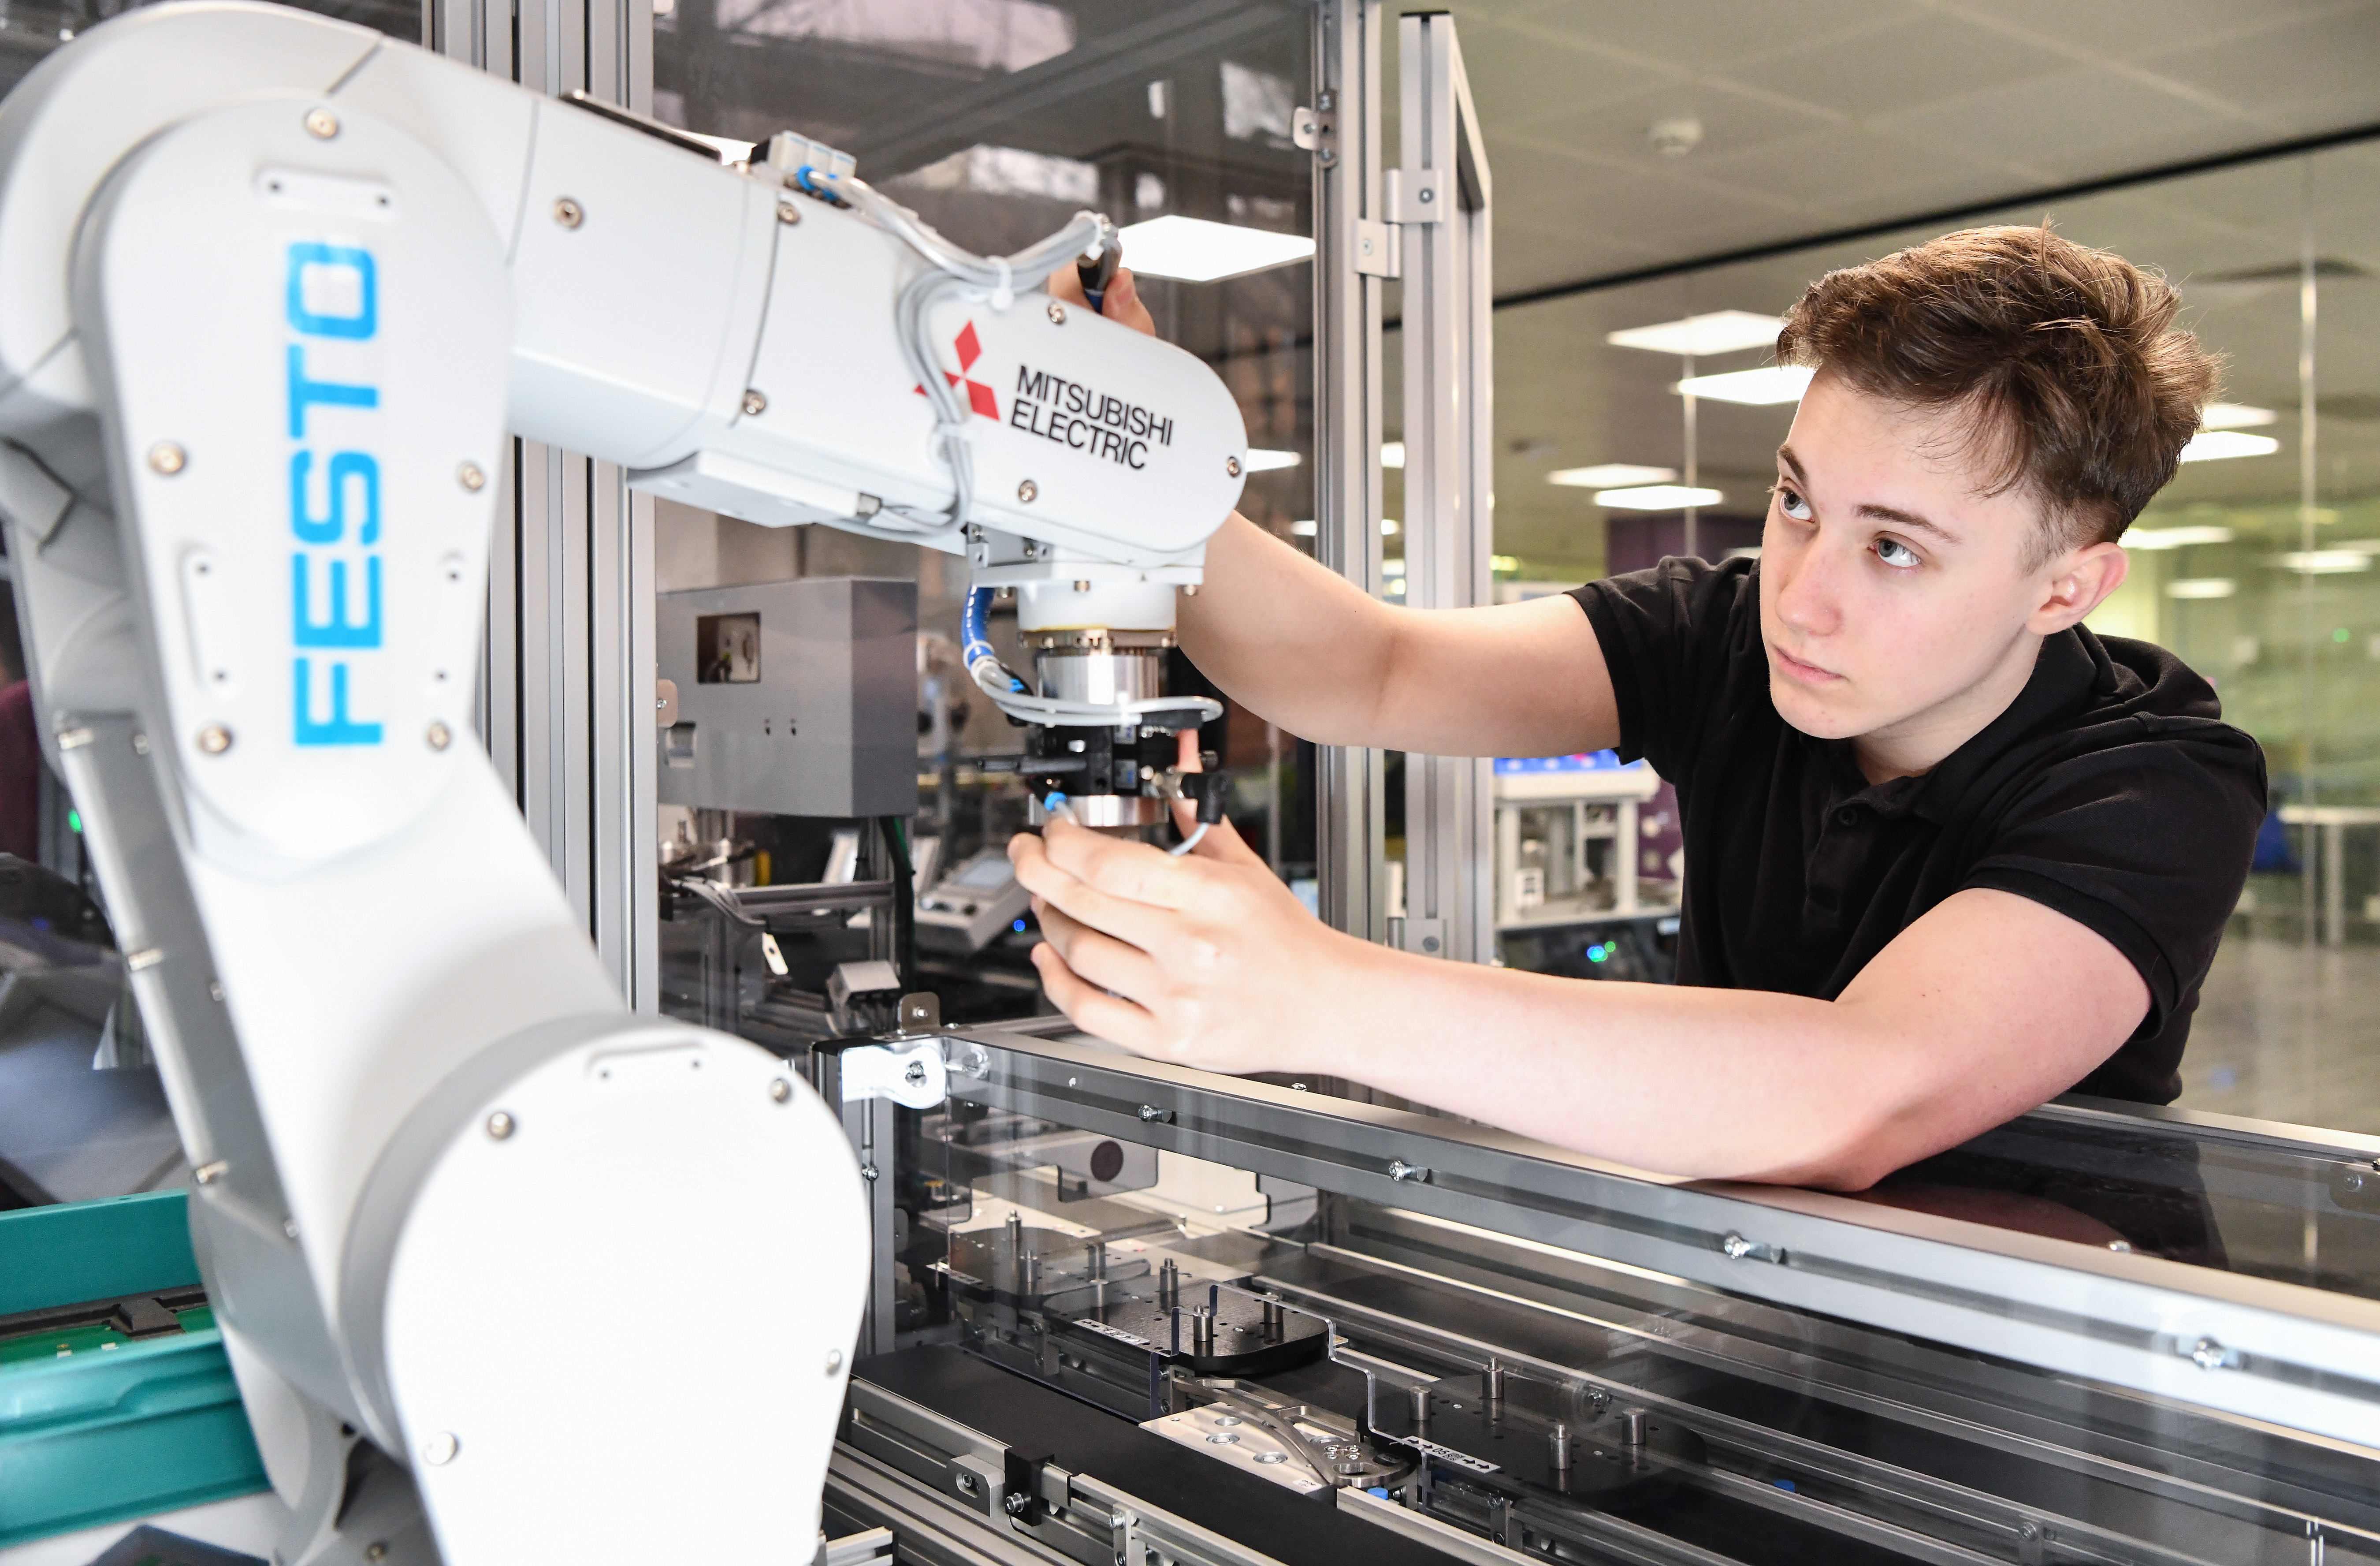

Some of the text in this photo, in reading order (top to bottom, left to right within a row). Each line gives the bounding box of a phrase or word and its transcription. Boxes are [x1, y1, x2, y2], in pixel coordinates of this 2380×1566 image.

[1011, 398, 1148, 470] ELECTRIC
[1017, 365, 1174, 447] MITSUBISHI
[286, 242, 382, 746] FESTO
